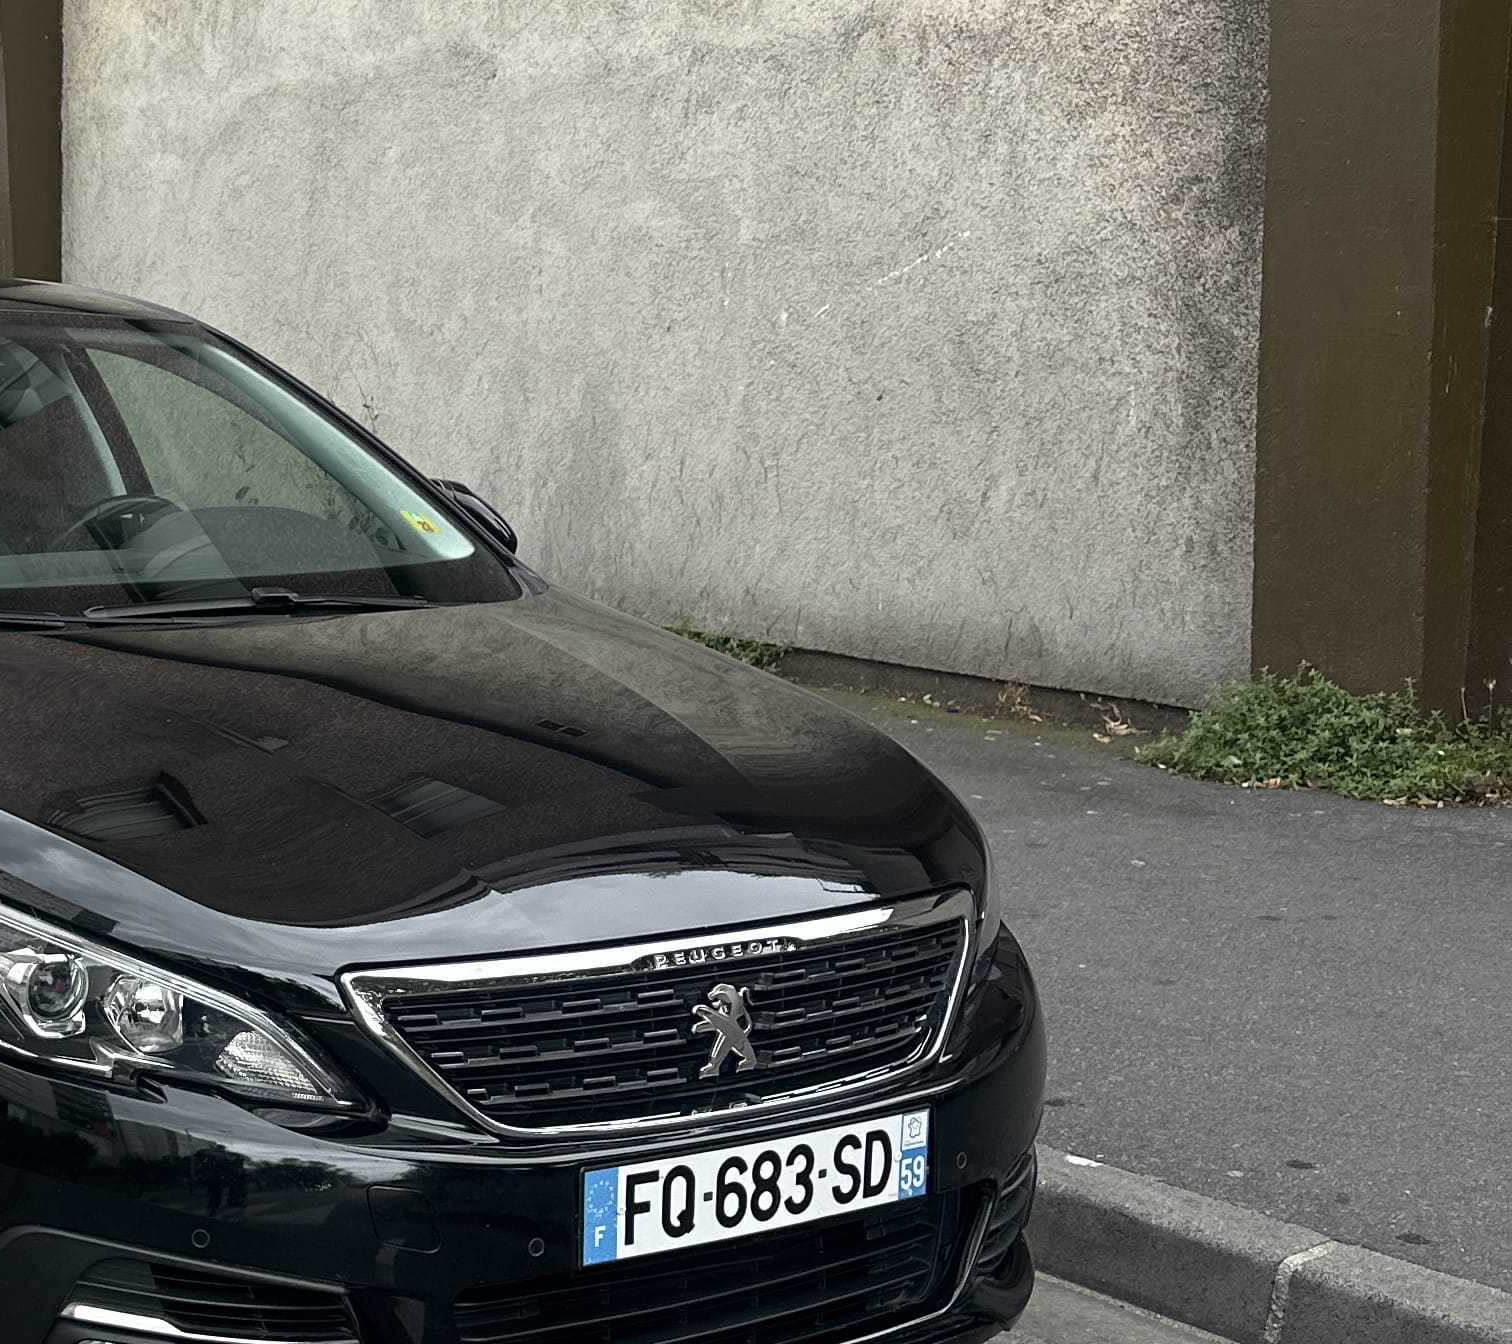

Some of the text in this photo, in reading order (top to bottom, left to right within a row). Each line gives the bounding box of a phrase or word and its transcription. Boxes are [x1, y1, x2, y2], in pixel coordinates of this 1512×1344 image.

[654, 939, 779, 969] PEUGEOT
[624, 1129, 893, 1246] FQ-683-SD
[900, 1155, 925, 1190] 59
[594, 1225, 606, 1247] F
